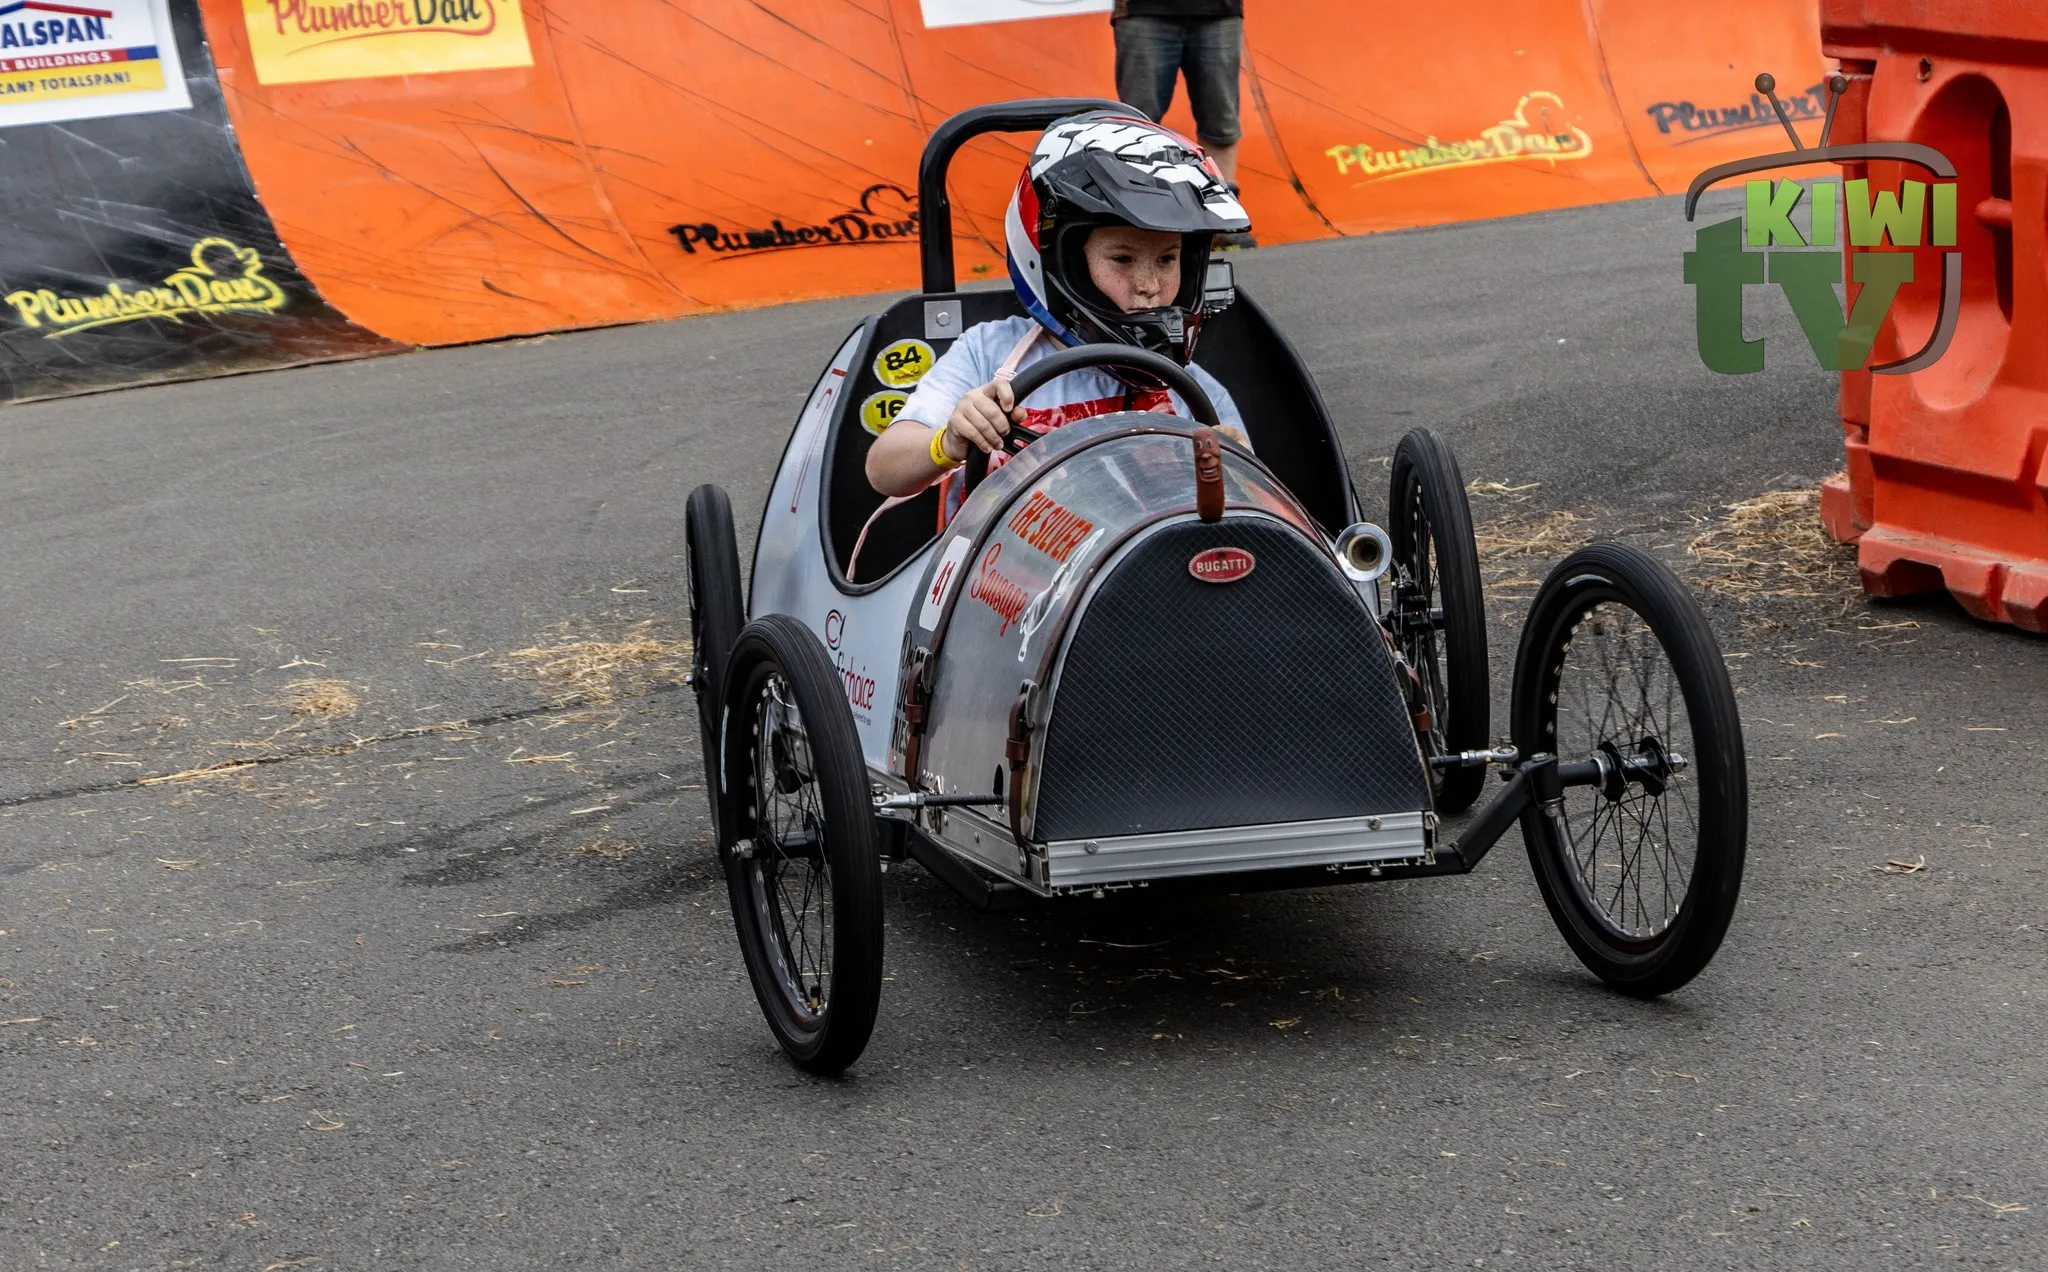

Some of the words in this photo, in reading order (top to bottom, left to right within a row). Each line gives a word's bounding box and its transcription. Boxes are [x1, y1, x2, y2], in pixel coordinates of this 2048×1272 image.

[15, 51, 112, 70] BUILDINGS
[40, 71, 131, 90] TOTALSPAN!
[885, 346, 922, 371] 84
[876, 400, 905, 418] 16
[1007, 490, 1056, 540] THE
[1027, 505, 1094, 565] SILVER
[1196, 558, 1247, 574] BUGATTI
[932, 561, 957, 606] 41
[970, 542, 1028, 638] Sausage
